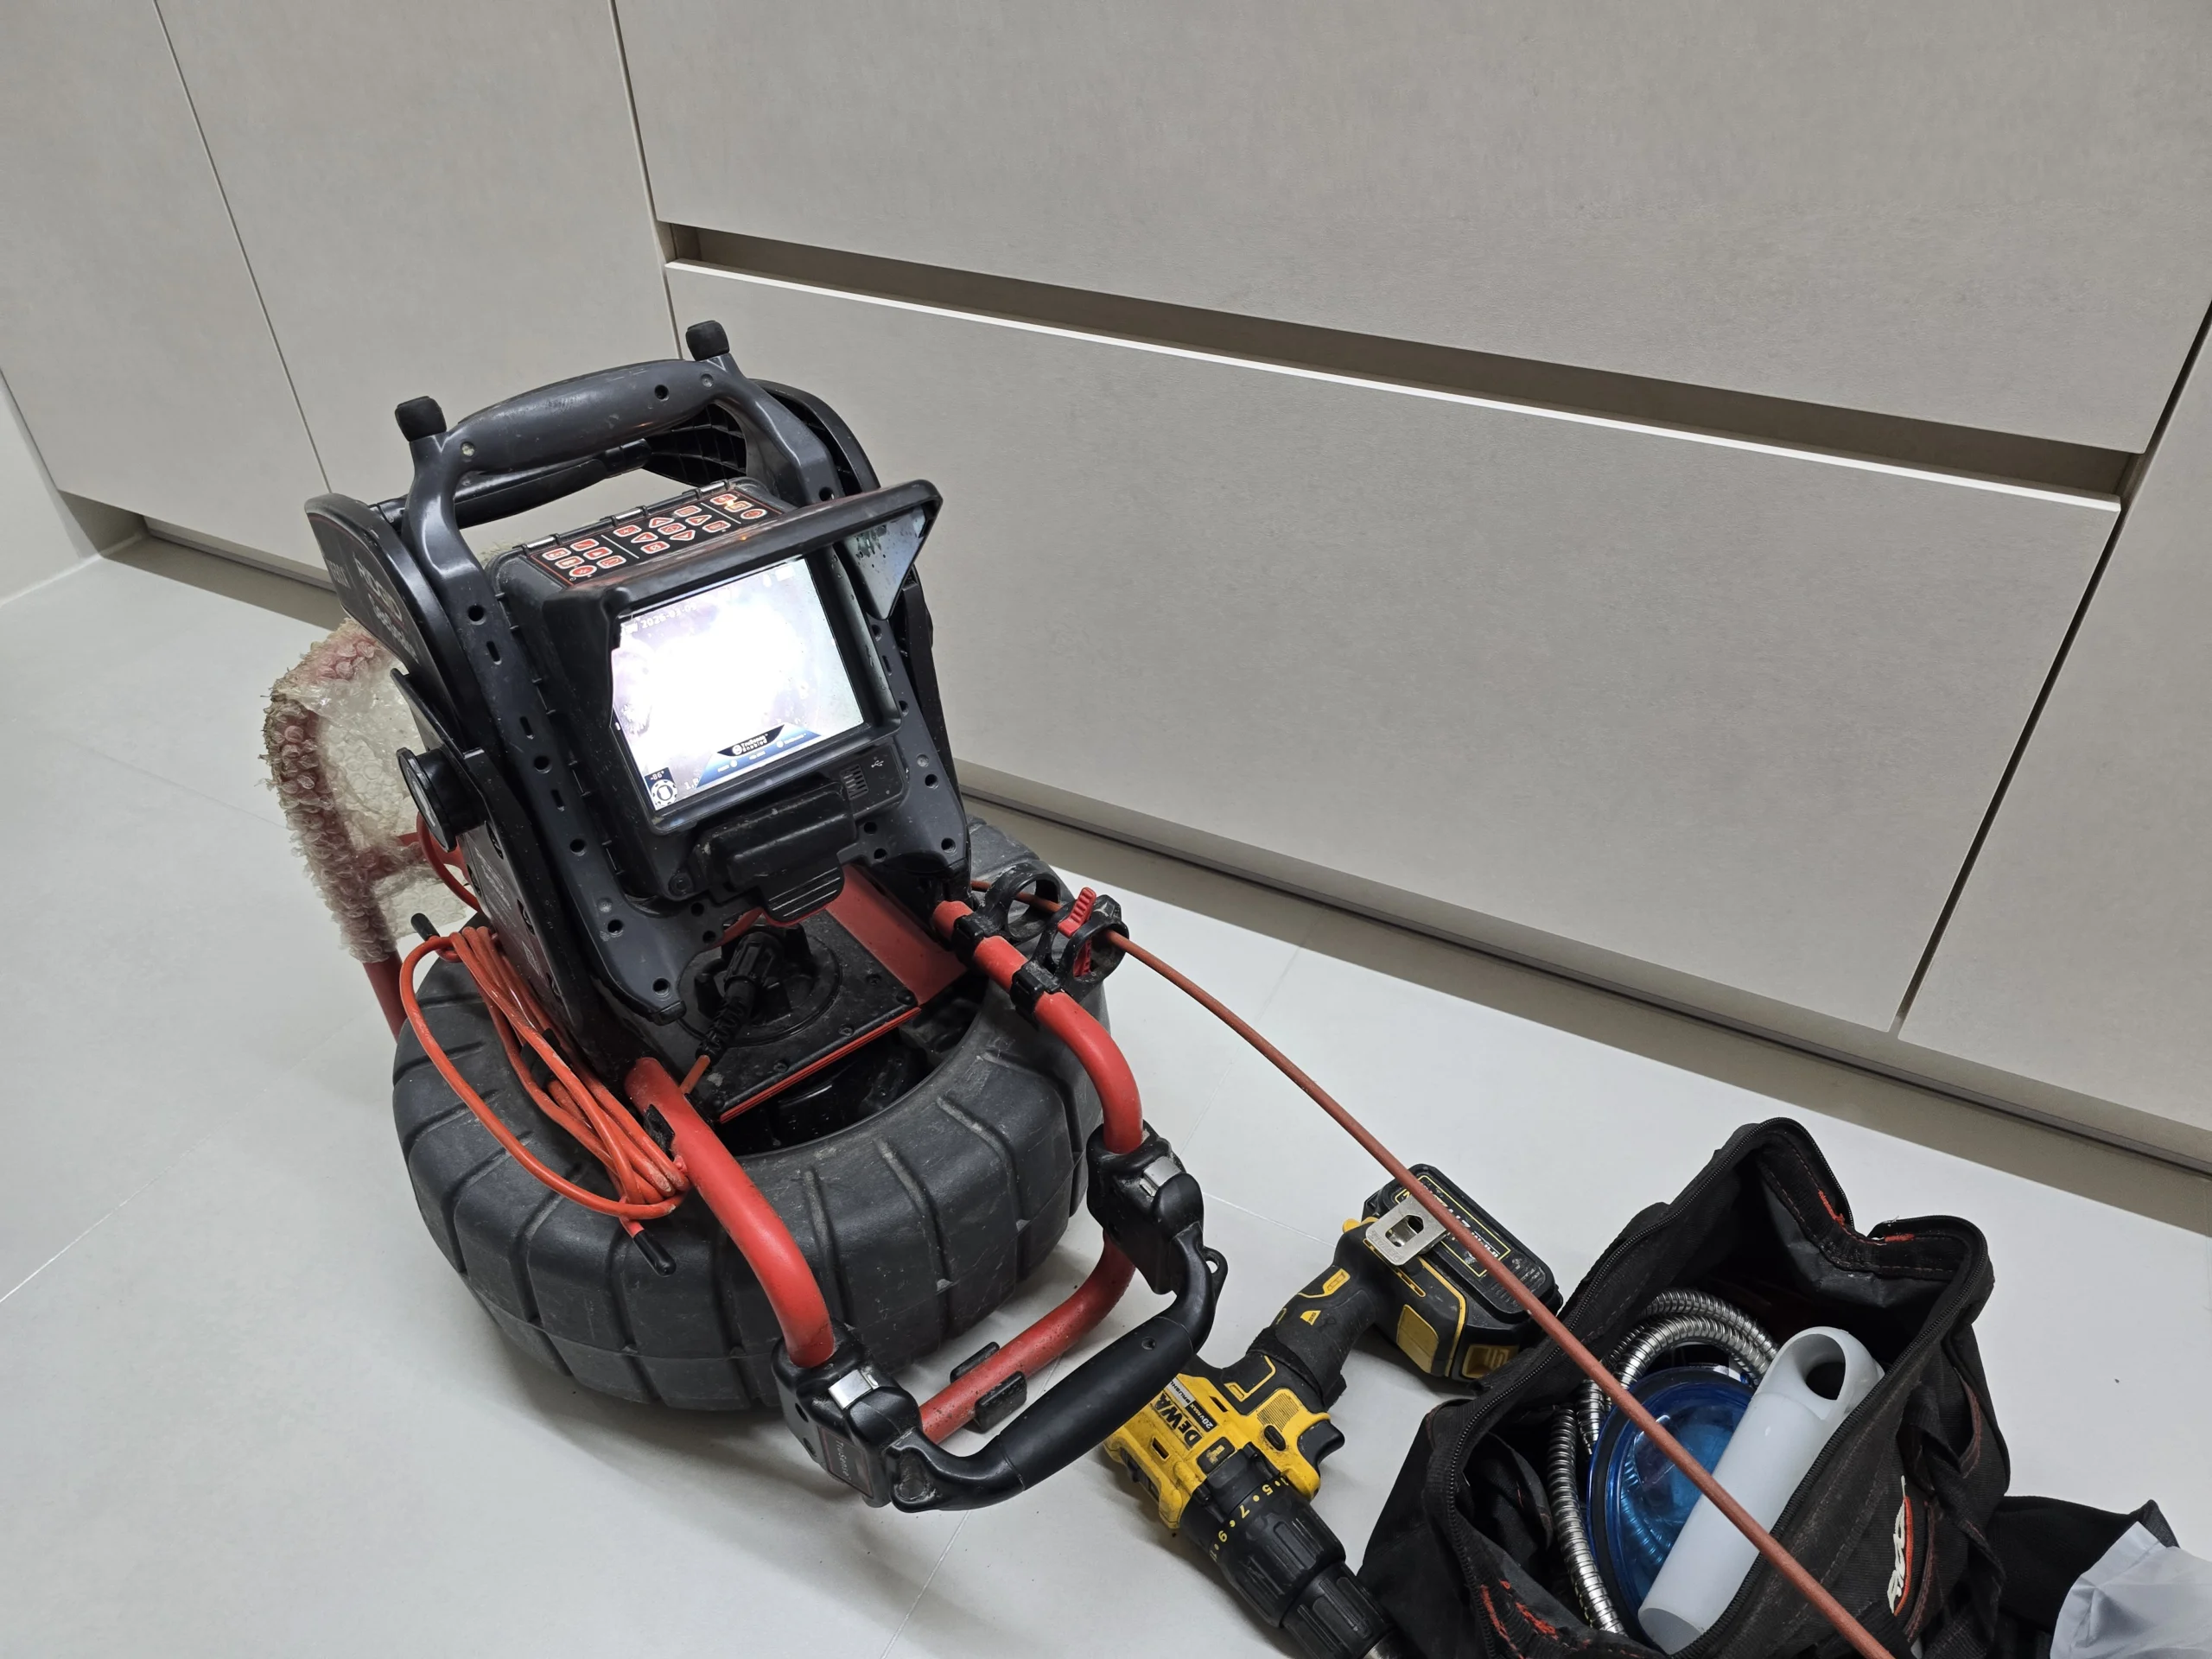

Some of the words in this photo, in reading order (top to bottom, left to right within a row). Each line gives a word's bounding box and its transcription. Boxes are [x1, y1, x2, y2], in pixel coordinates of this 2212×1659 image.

[1262, 1484, 1274, 1496] 5
[1240, 1504, 1250, 1518] 7
[1218, 1530, 1228, 1542] 9
